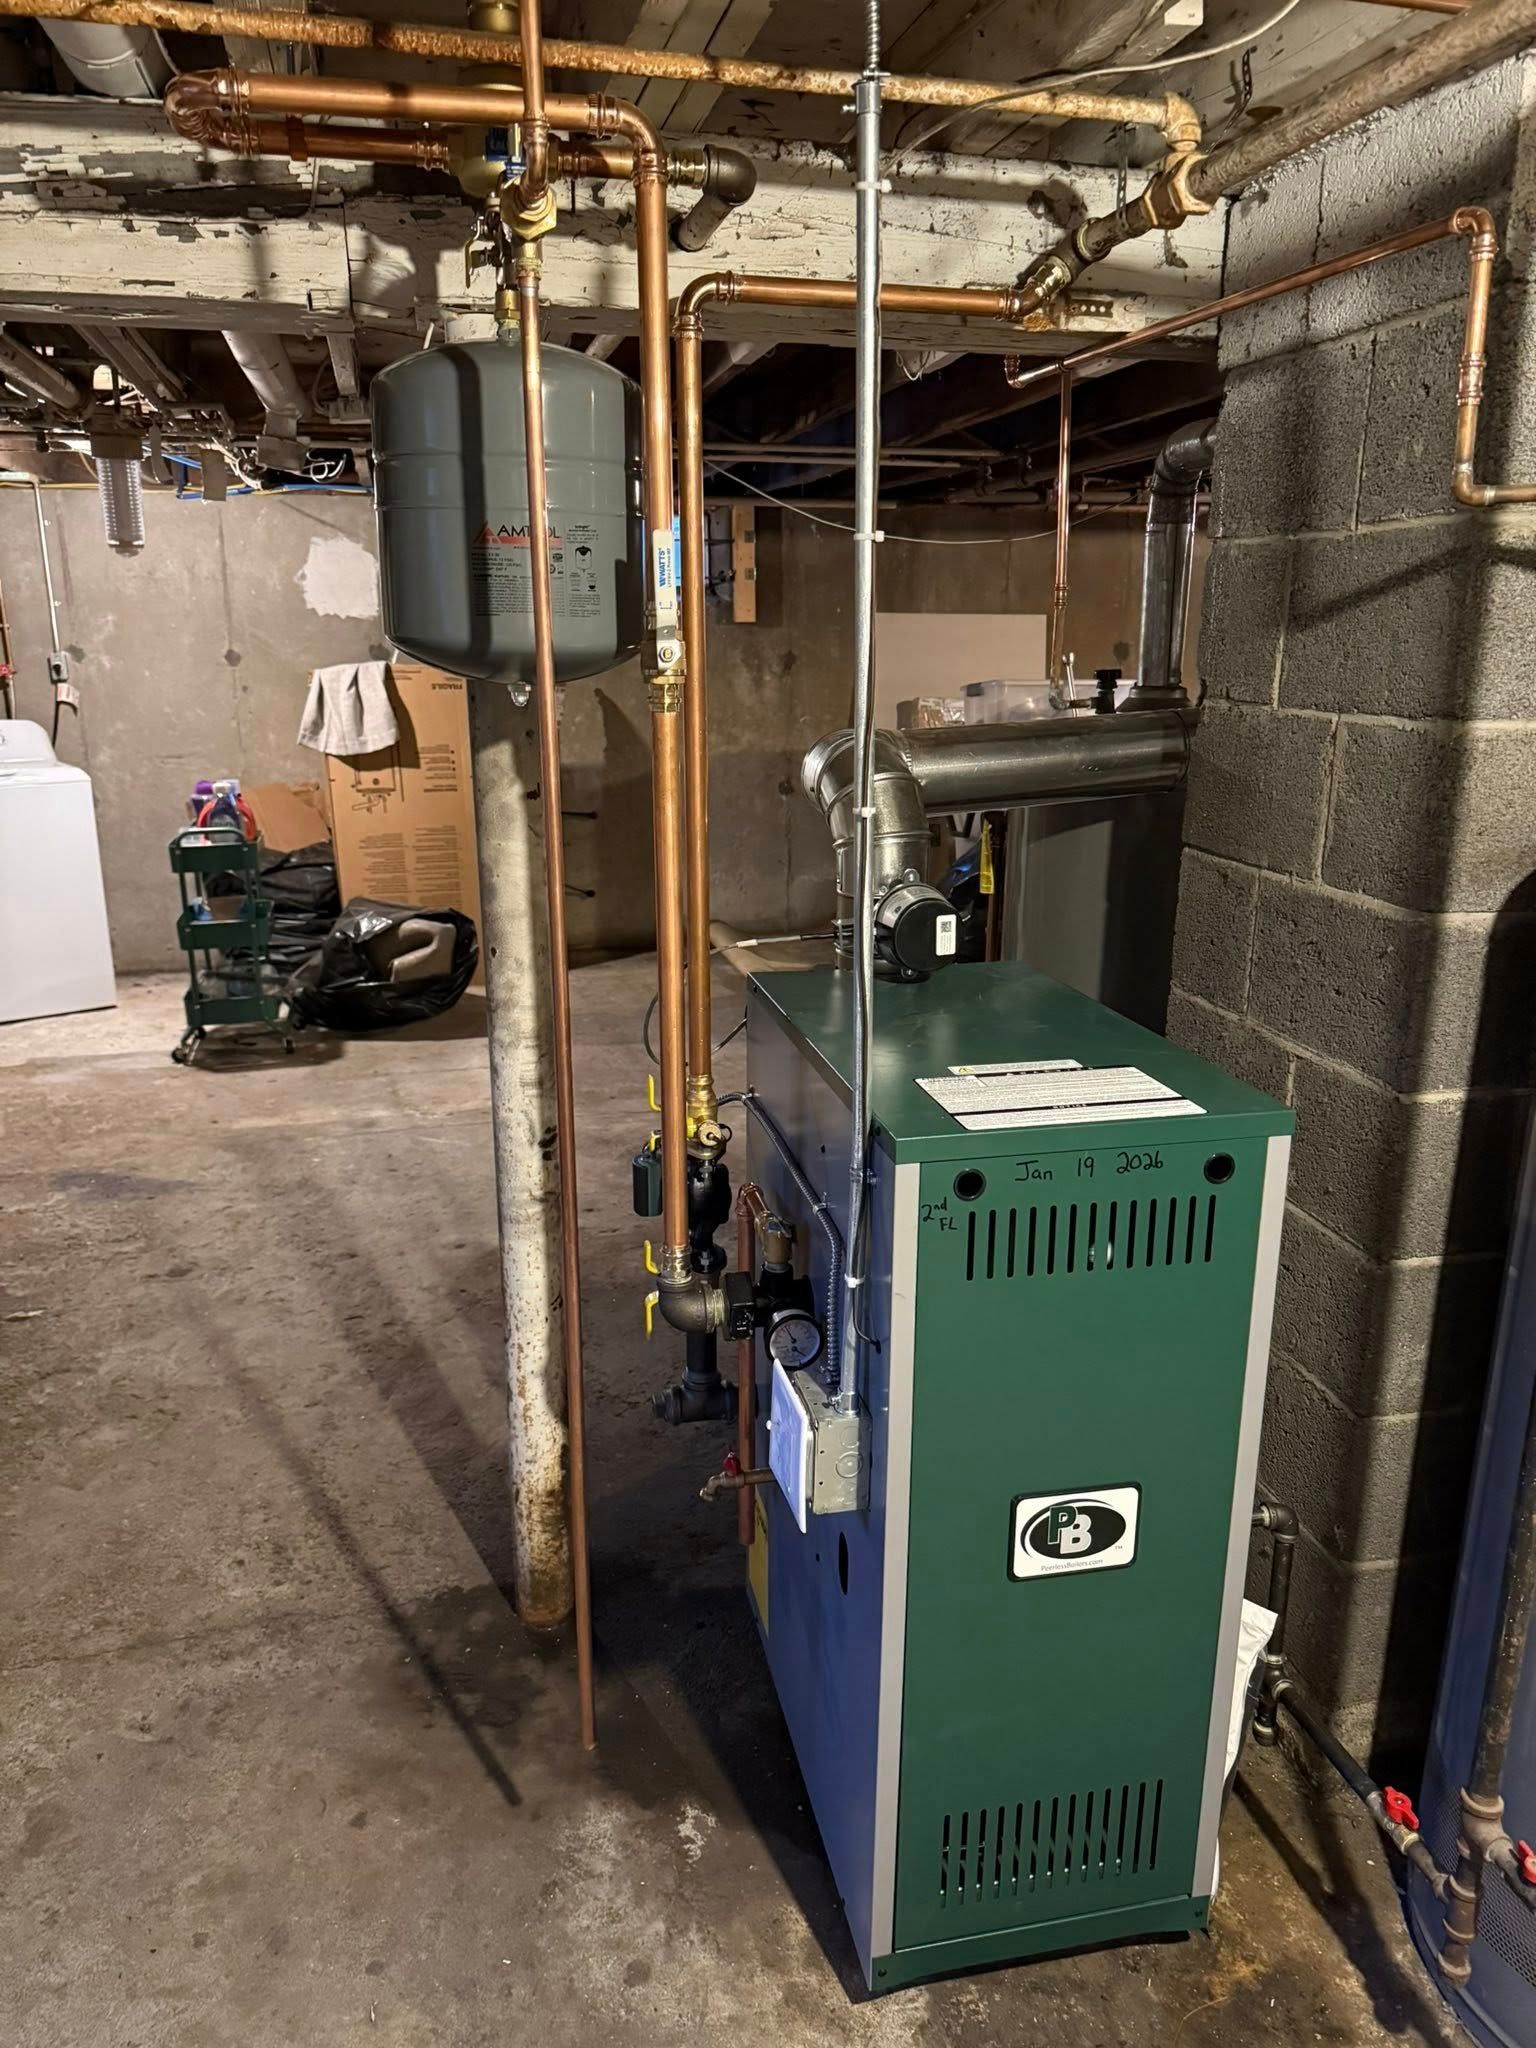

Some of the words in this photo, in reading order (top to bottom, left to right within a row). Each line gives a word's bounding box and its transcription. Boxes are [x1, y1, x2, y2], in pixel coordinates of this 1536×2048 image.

[497, 524, 561, 538] AMTOL
[658, 549, 666, 586] WATTS
[1014, 1160, 1053, 1182] Jan
[1077, 1156, 1095, 1178] 19
[1116, 1151, 1164, 1174] 2026
[921, 1196, 947, 1222] 2nd
[940, 1214, 957, 1231] FL
[1041, 1559, 1104, 1571] PeerlessBoilers.com
